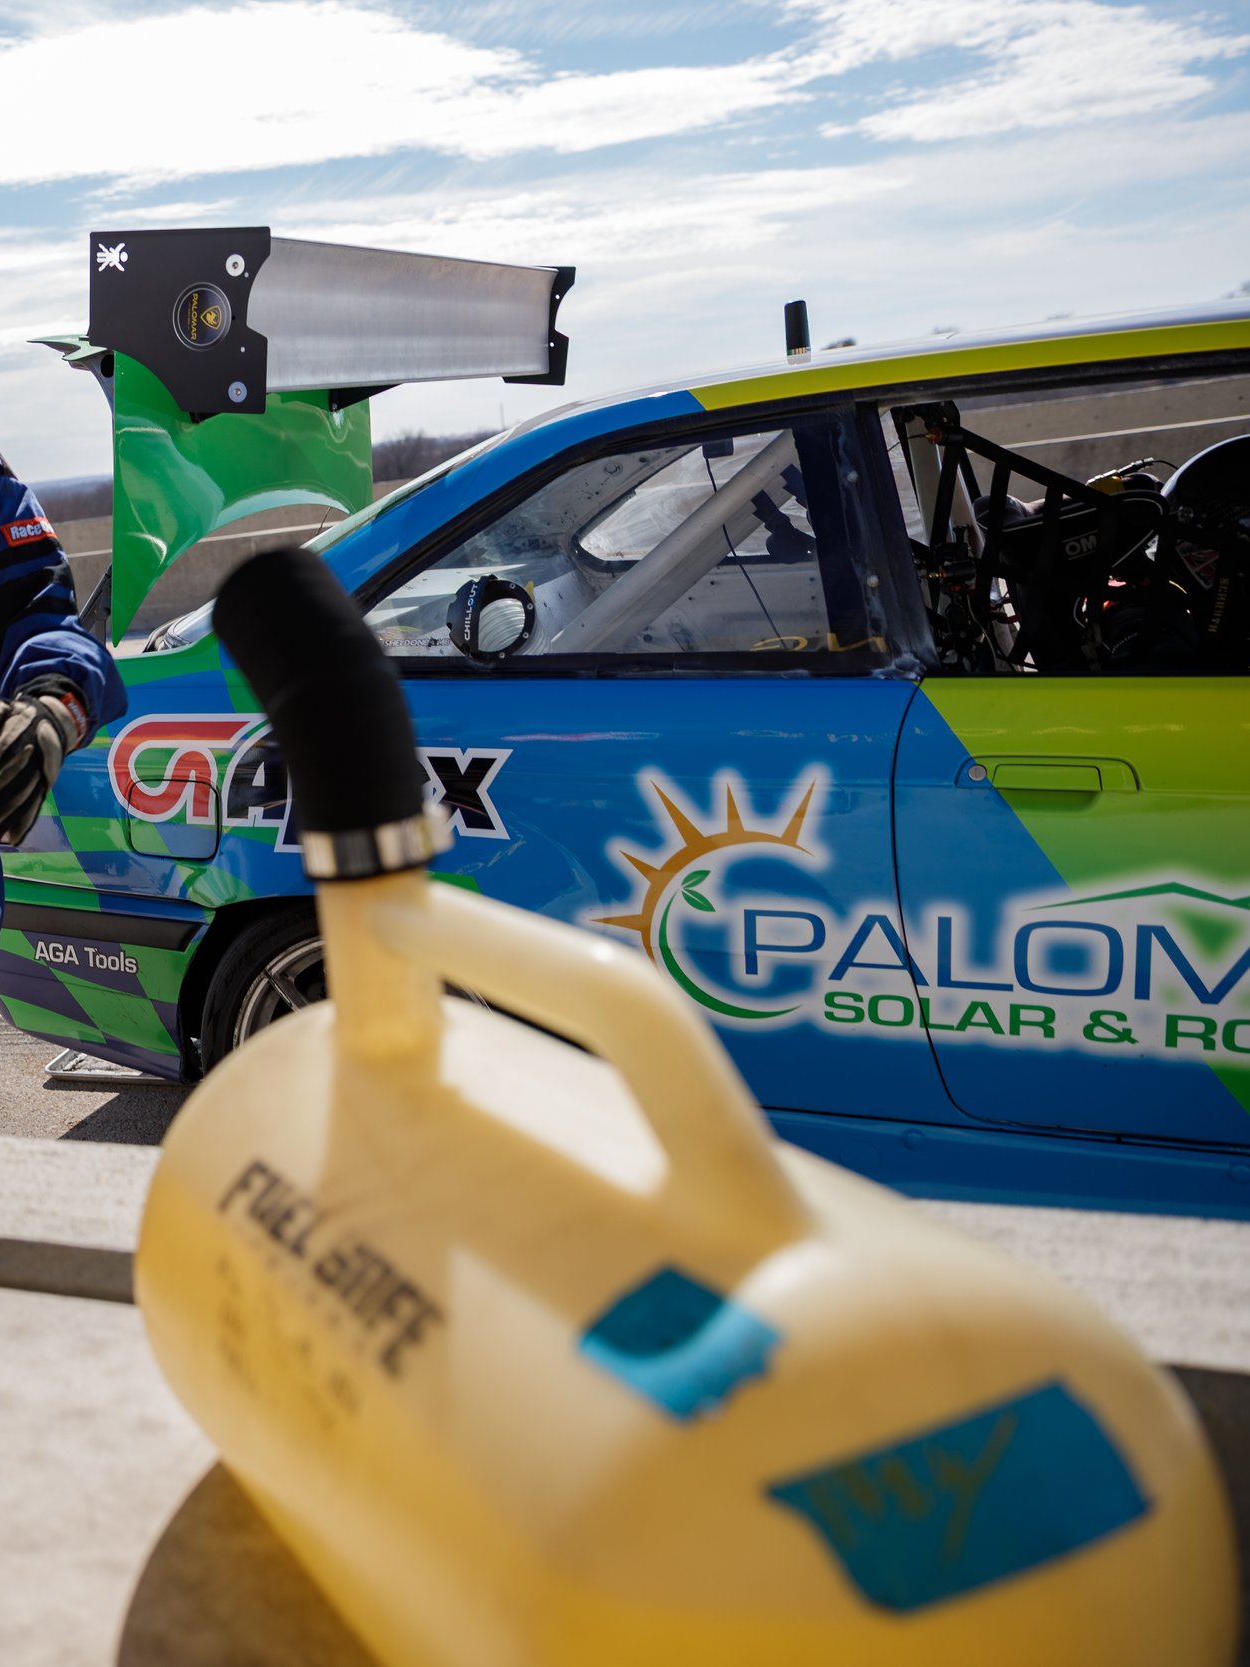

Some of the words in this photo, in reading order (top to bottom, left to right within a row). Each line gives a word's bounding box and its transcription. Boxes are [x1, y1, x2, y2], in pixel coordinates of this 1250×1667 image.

[1064, 534, 1098, 557] OM
[464, 583, 478, 641] CHILLOUT
[34, 940, 79, 966] AGA
[83, 946, 138, 974] Tools
[824, 991, 1056, 1039] SOLAR
[1083, 1009, 1140, 1045] &
